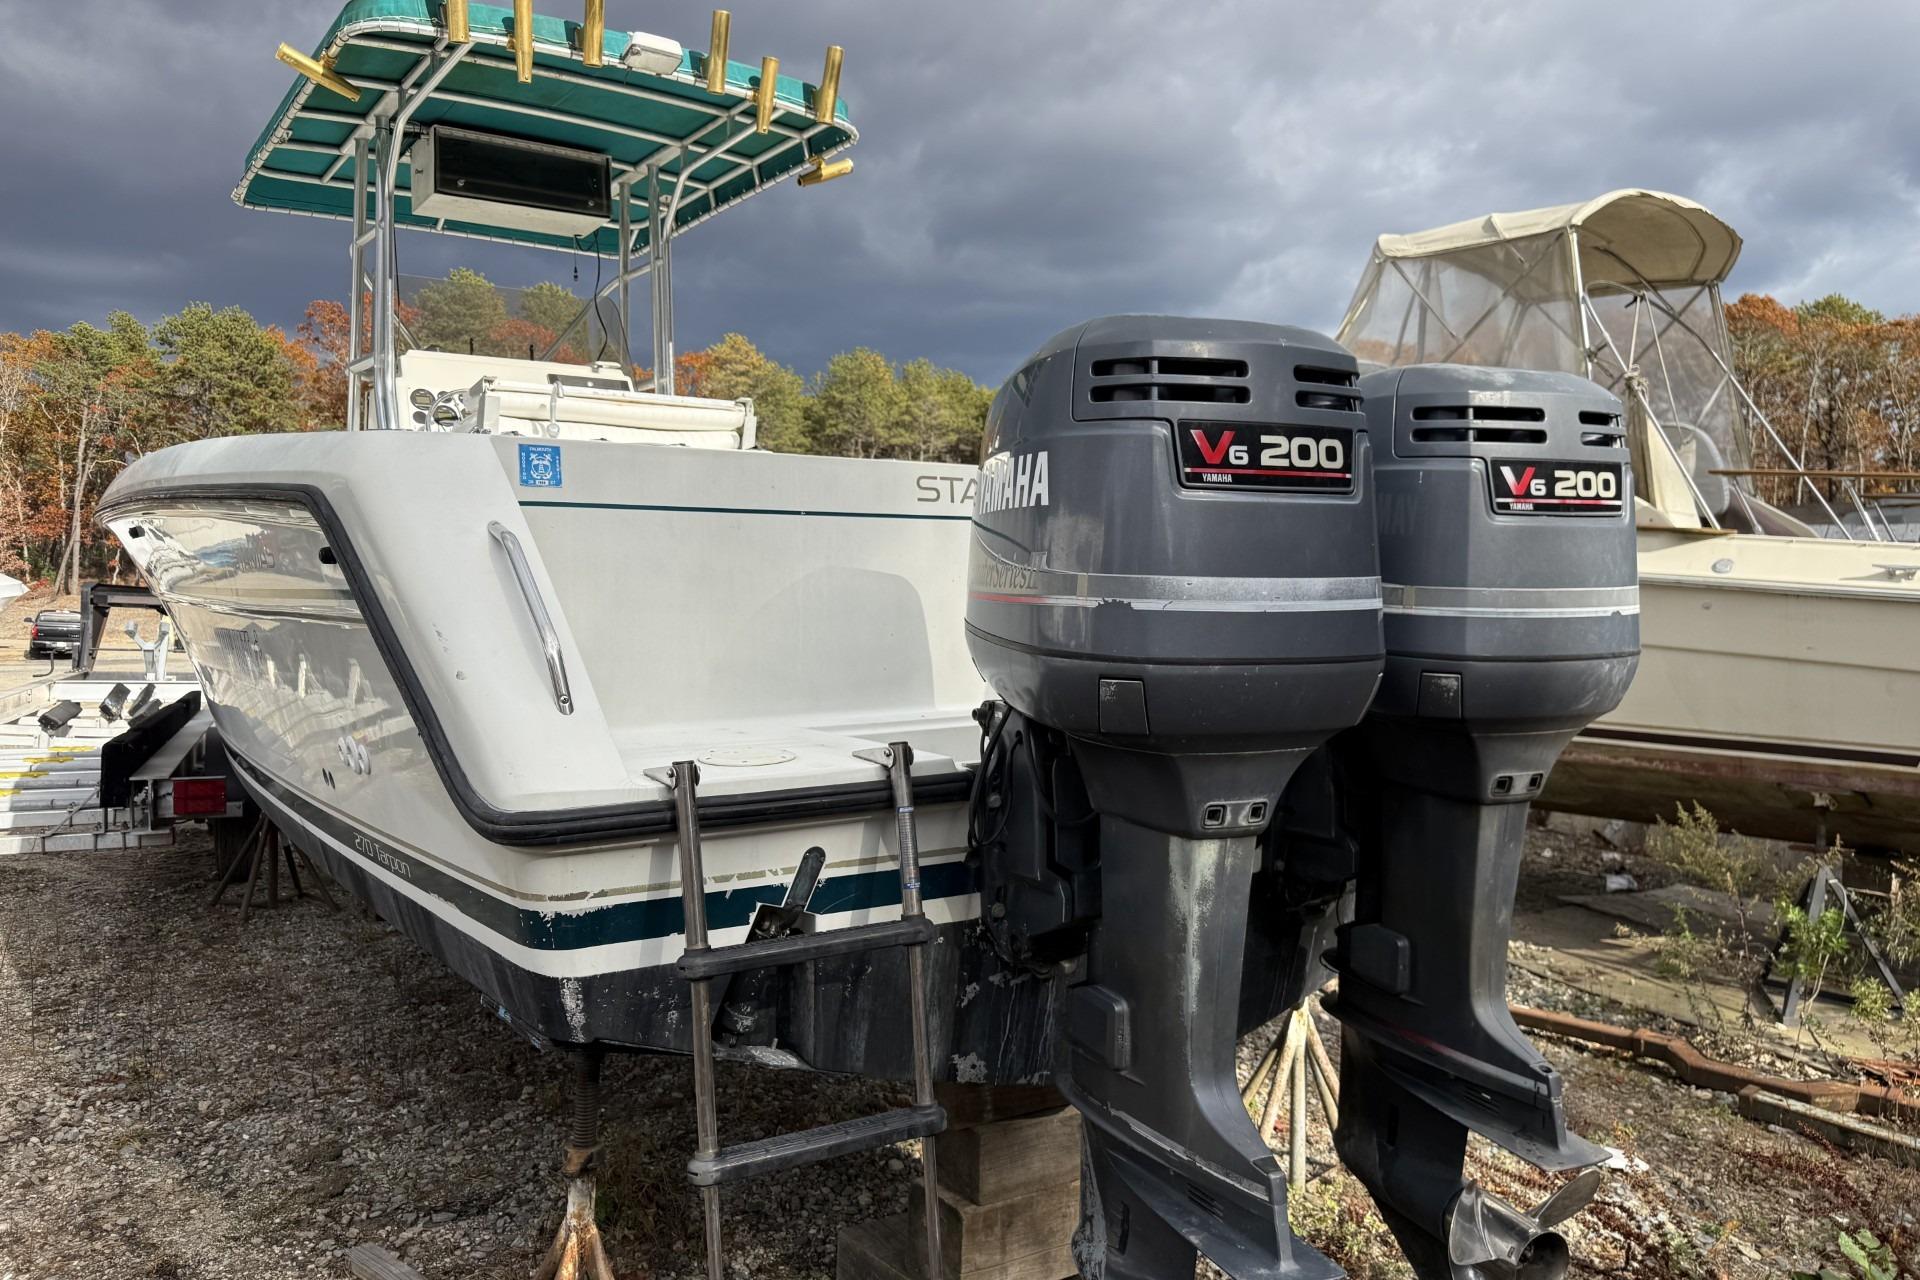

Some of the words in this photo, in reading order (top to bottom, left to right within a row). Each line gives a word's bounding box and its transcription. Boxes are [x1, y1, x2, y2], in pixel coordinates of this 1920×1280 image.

[1190, 429, 1249, 466] V6
[1260, 434, 1345, 470] 200
[980, 451, 1049, 515] YAMAHA
[1202, 473, 1233, 483] YAMAHA
[1500, 466, 1547, 496] V6
[1554, 470, 1616, 498] 200
[1509, 503, 1534, 511] YAMAHA
[353, 832, 374, 857] 270
[374, 843, 411, 878] Tarpon
